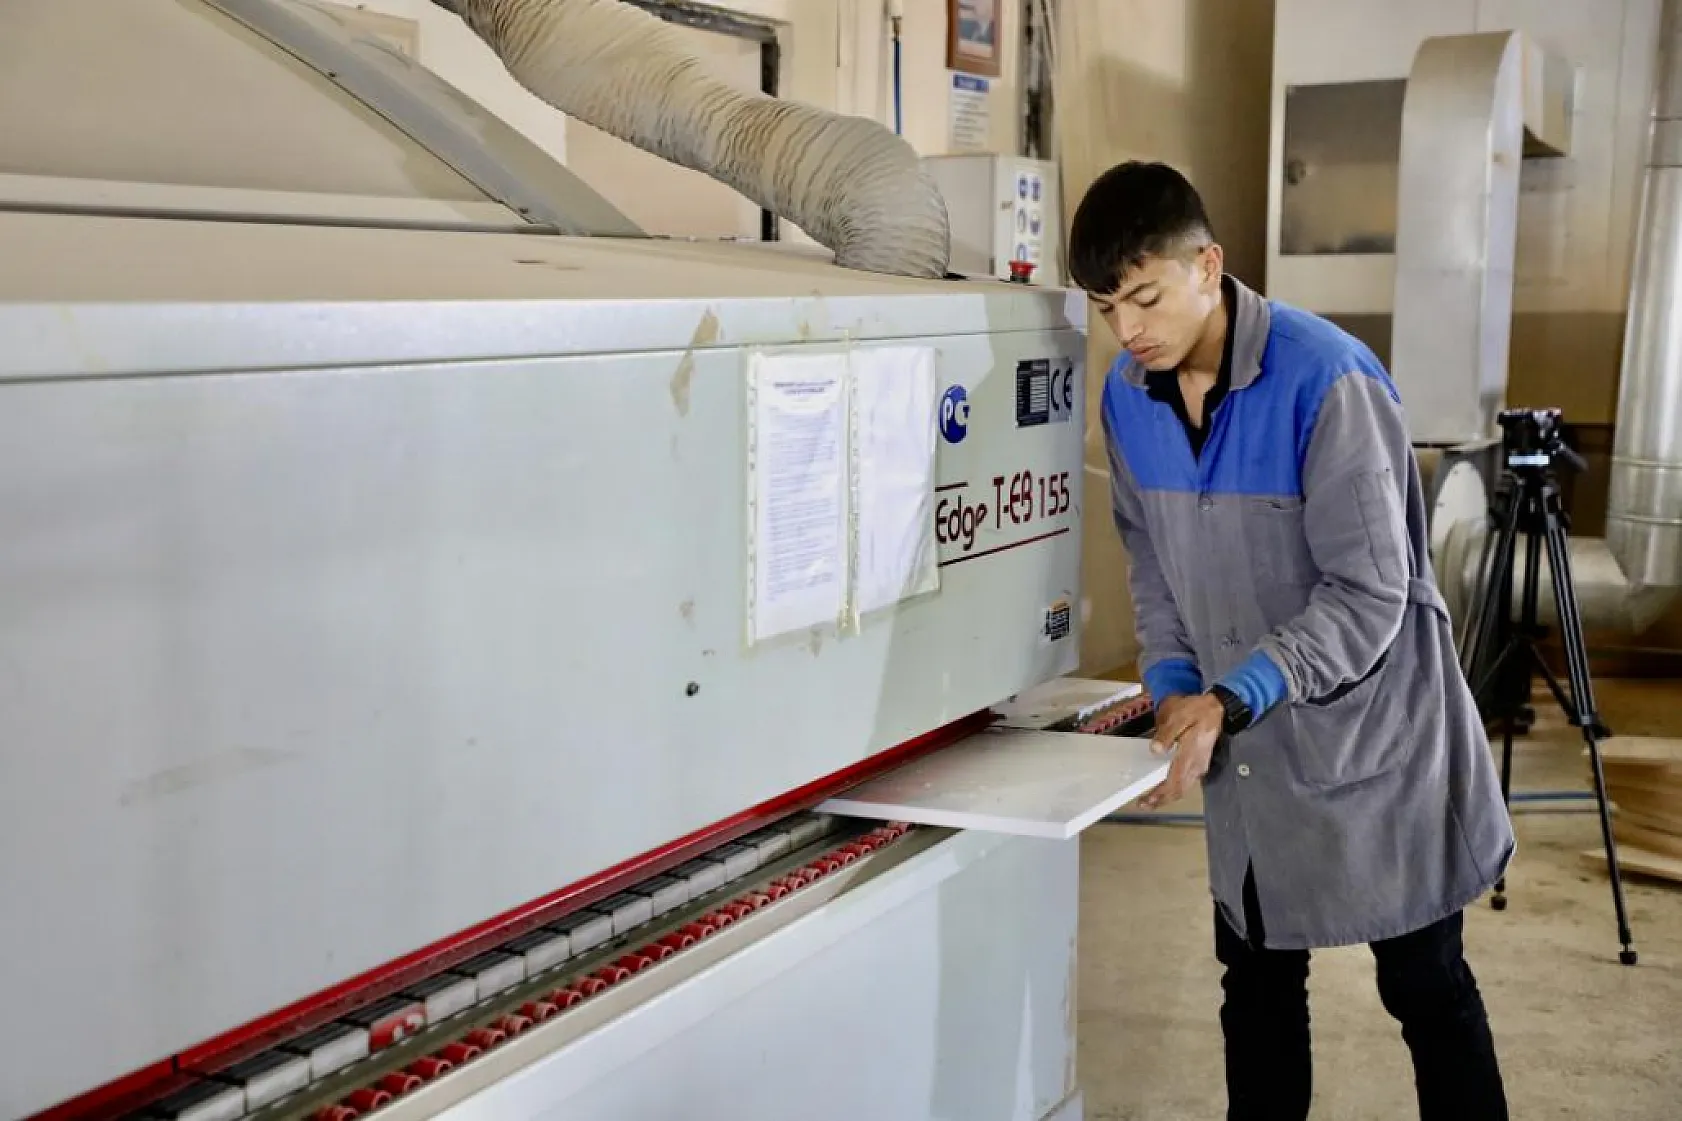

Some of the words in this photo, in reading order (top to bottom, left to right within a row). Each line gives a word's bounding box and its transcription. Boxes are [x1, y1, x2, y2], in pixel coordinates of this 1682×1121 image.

[1050, 366, 1072, 411] CE
[935, 494, 987, 551] Edge
[1038, 471, 1069, 518] 155
